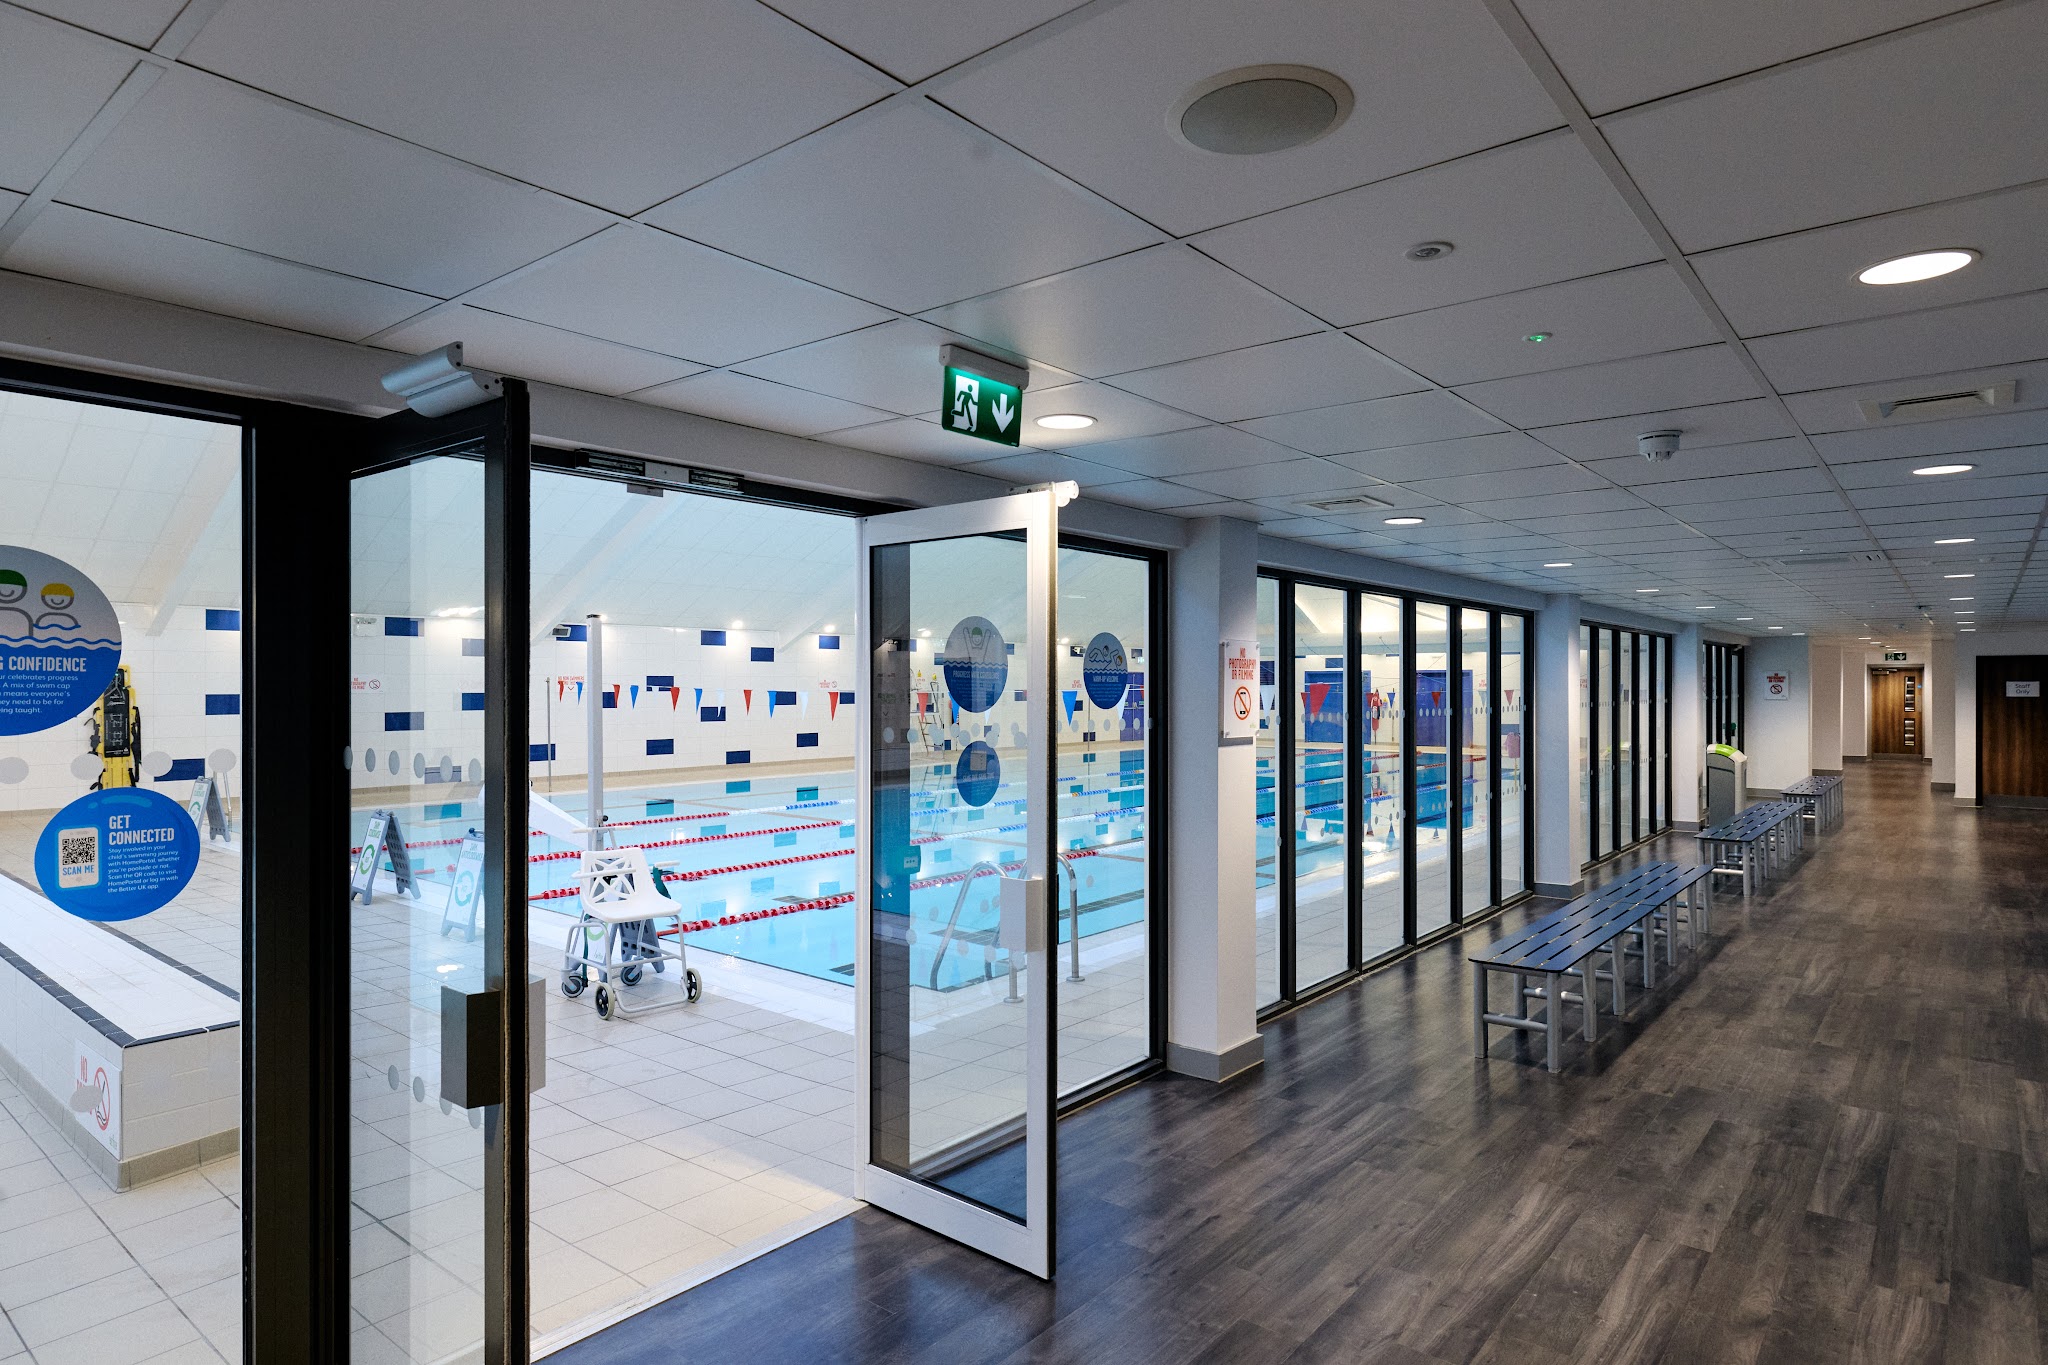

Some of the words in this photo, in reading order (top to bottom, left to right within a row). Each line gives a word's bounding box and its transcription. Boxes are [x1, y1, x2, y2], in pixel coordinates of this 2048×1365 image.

[9, 656, 86, 672] CONFIDENCE
[109, 815, 131, 829] GET
[109, 828, 174, 845] CONNECTED
[63, 866, 81, 875] SCAN
[85, 865, 95, 873] ME
[81, 1055, 88, 1083] NO
